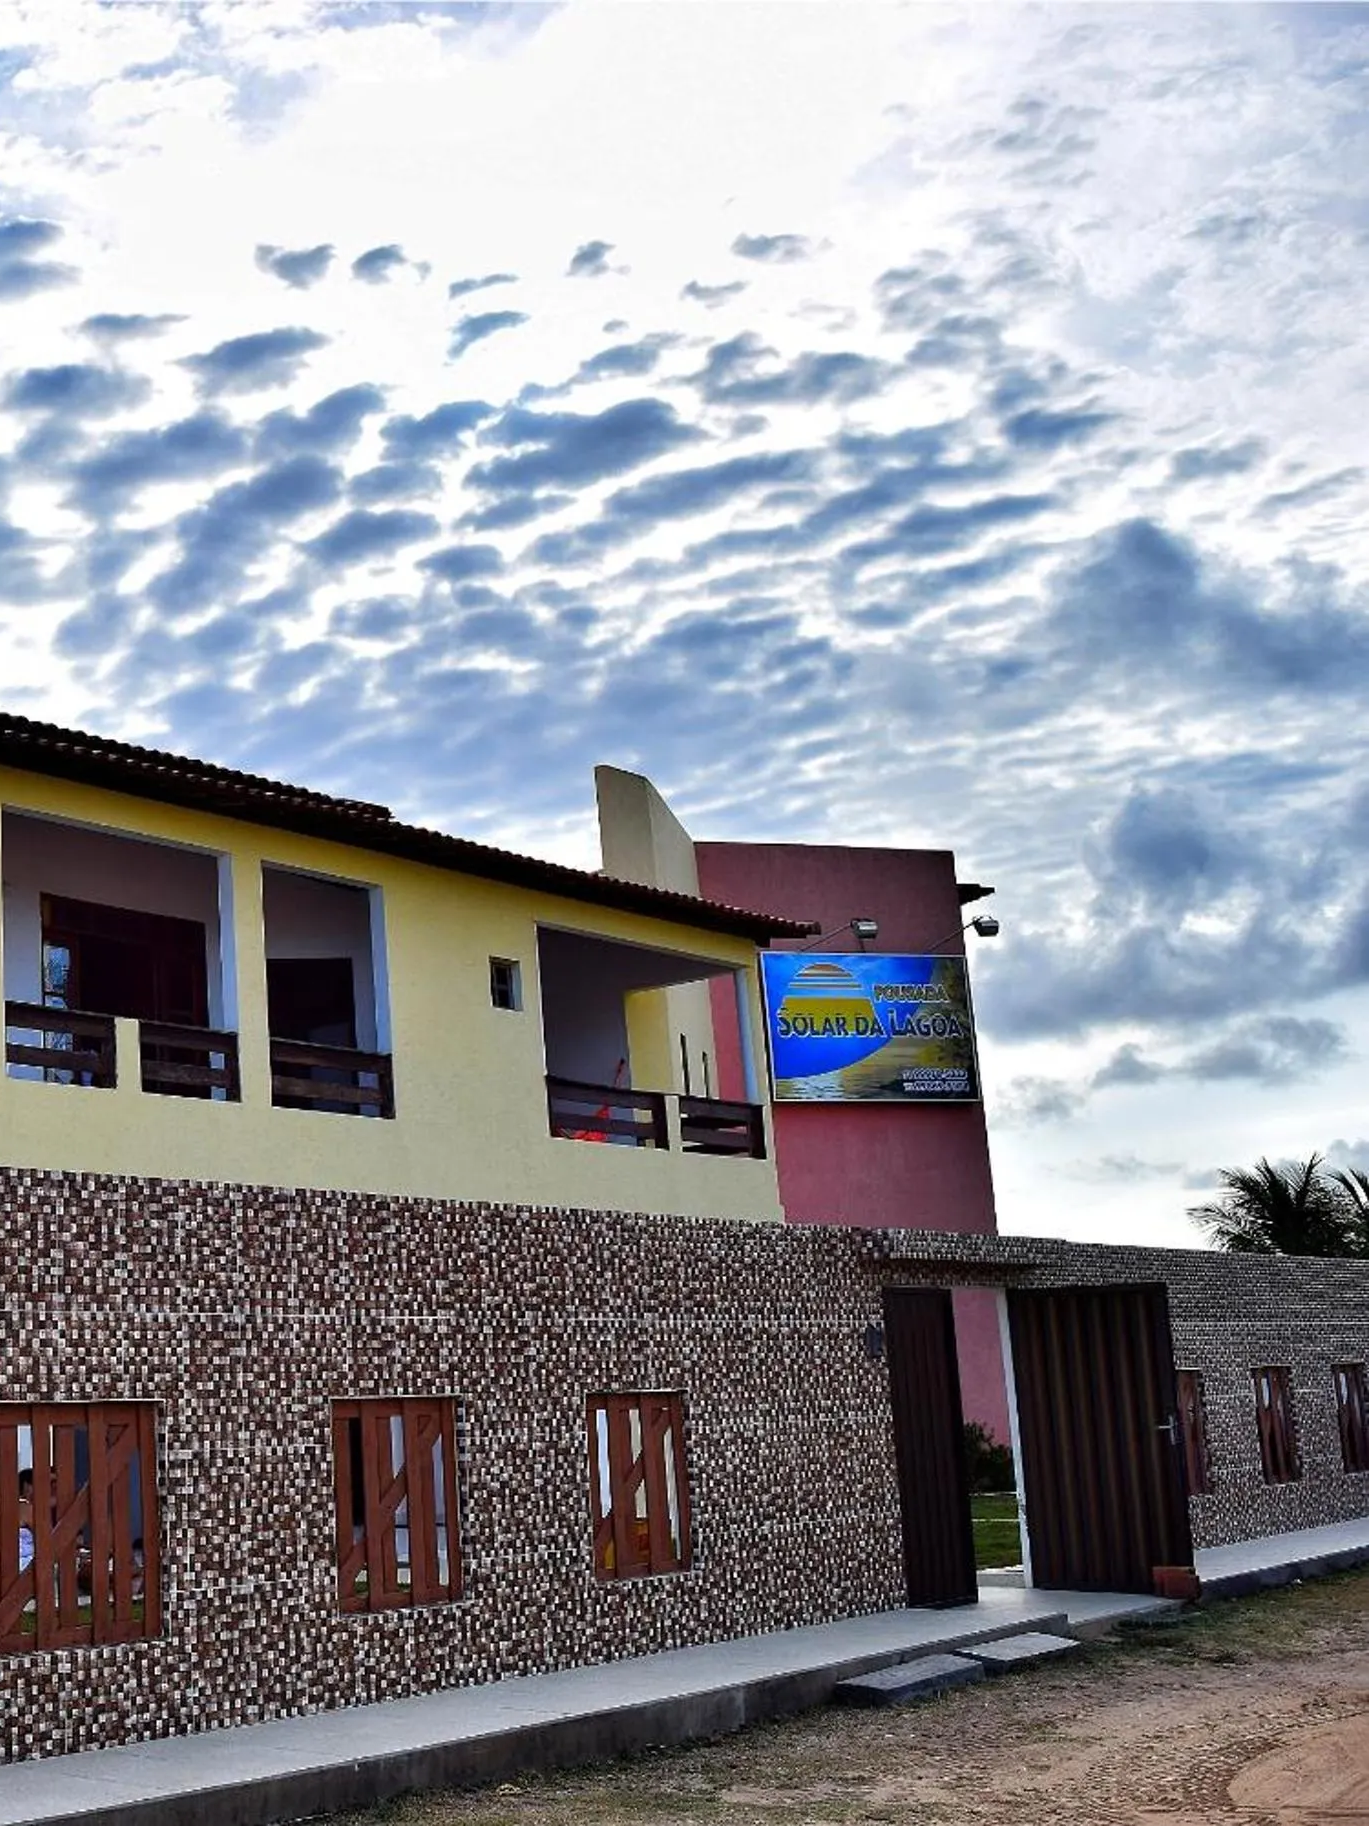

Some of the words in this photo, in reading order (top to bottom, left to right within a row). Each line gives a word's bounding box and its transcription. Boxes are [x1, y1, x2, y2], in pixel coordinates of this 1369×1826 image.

[777, 1008, 848, 1038] SOLAR
[854, 1014, 887, 1038] DA
[888, 1009, 965, 1039] LAGOA
